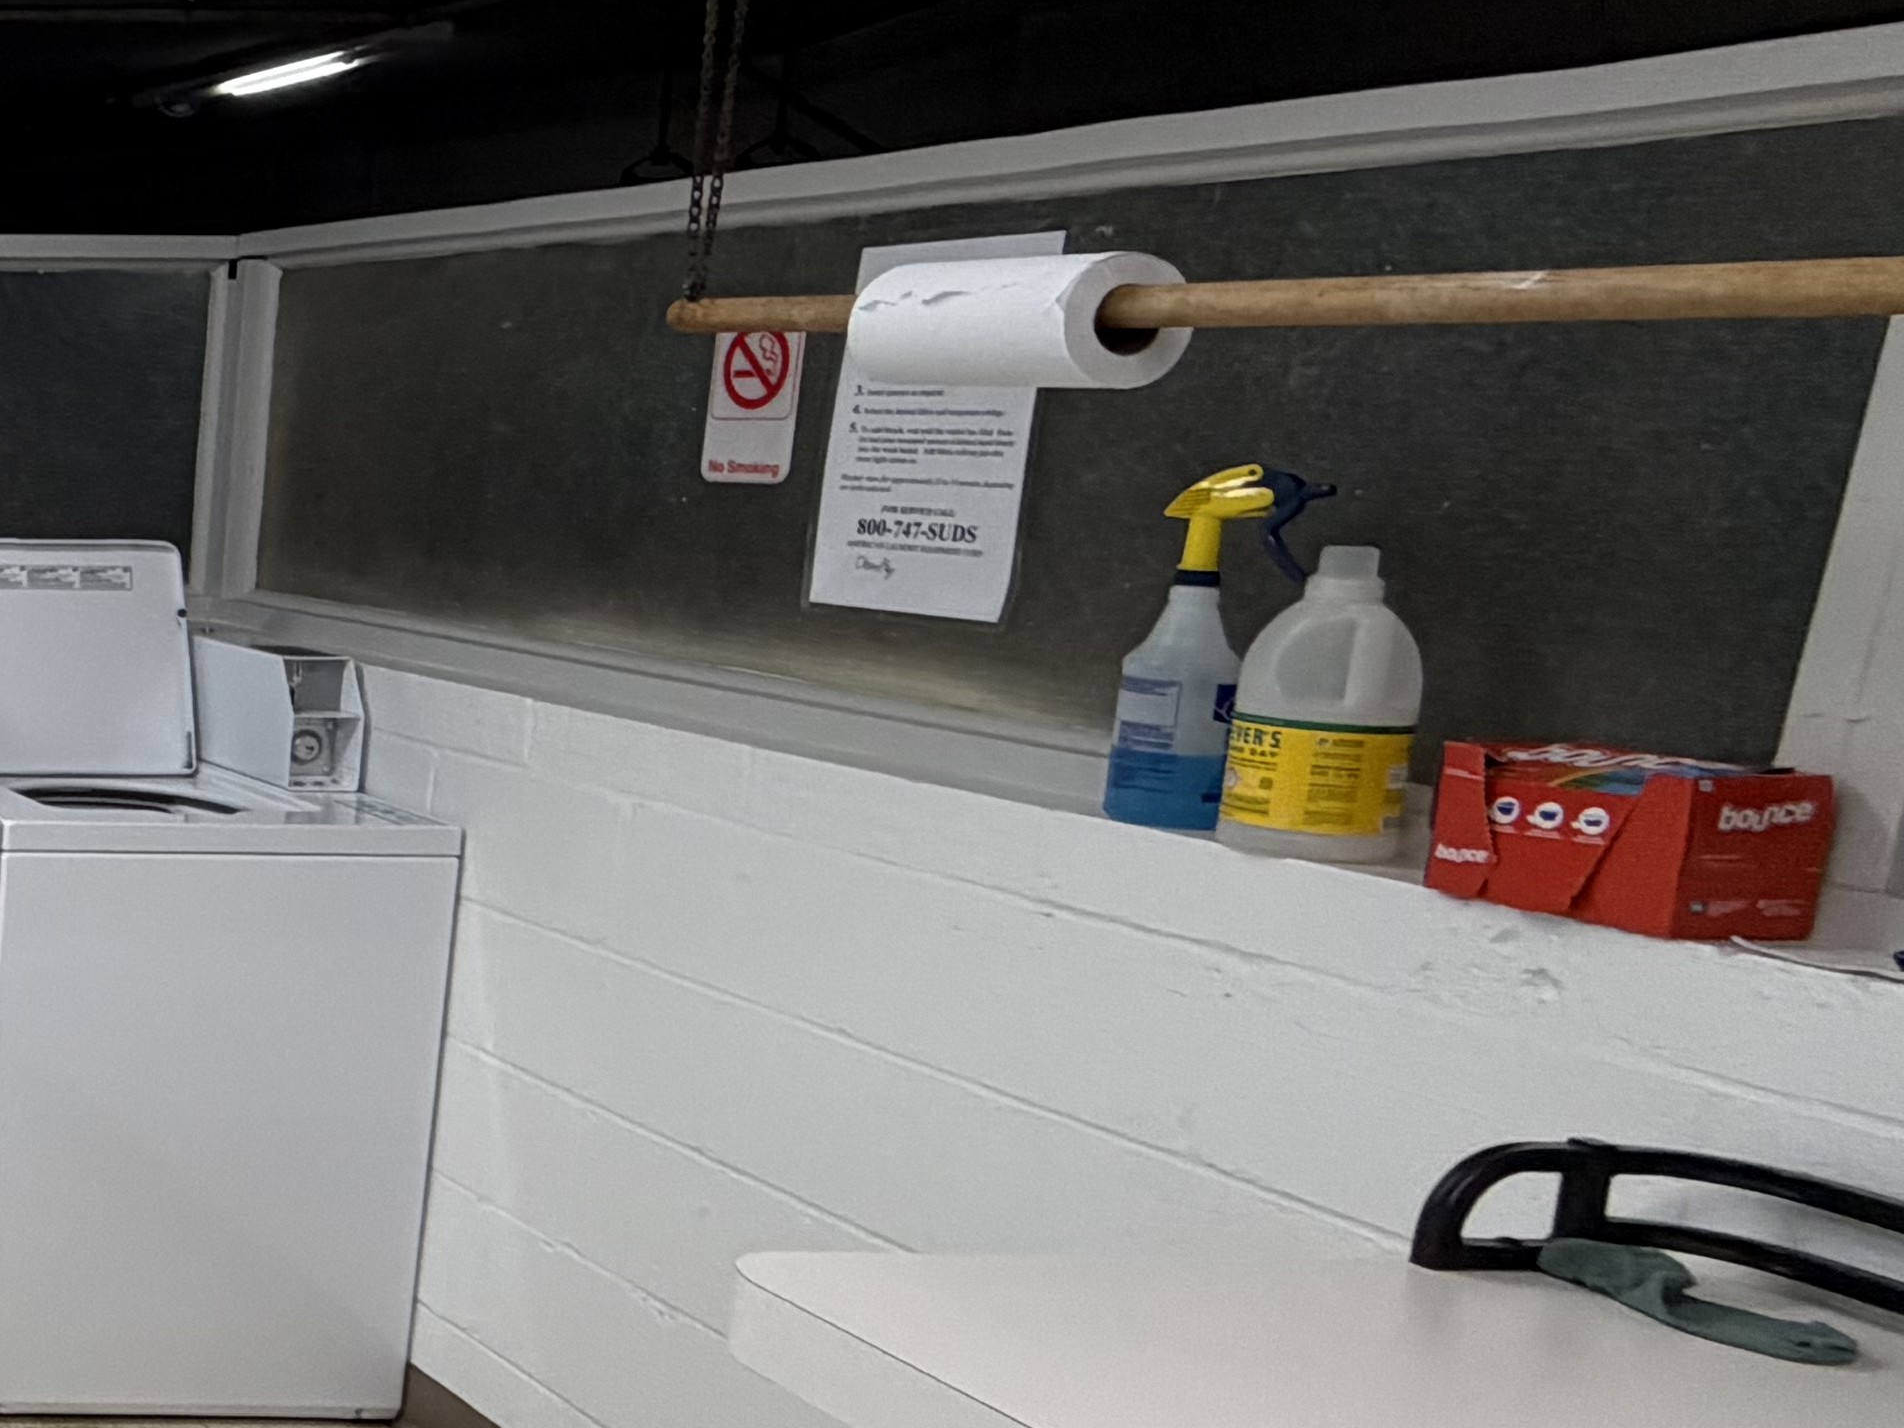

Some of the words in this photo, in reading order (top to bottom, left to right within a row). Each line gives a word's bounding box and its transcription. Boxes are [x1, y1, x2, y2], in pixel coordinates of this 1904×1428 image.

[708, 459, 725, 474] No
[726, 459, 780, 479] Smoking
[856, 518, 979, 544] 800-747-SUDS
[1717, 800, 1817, 833] bounce
